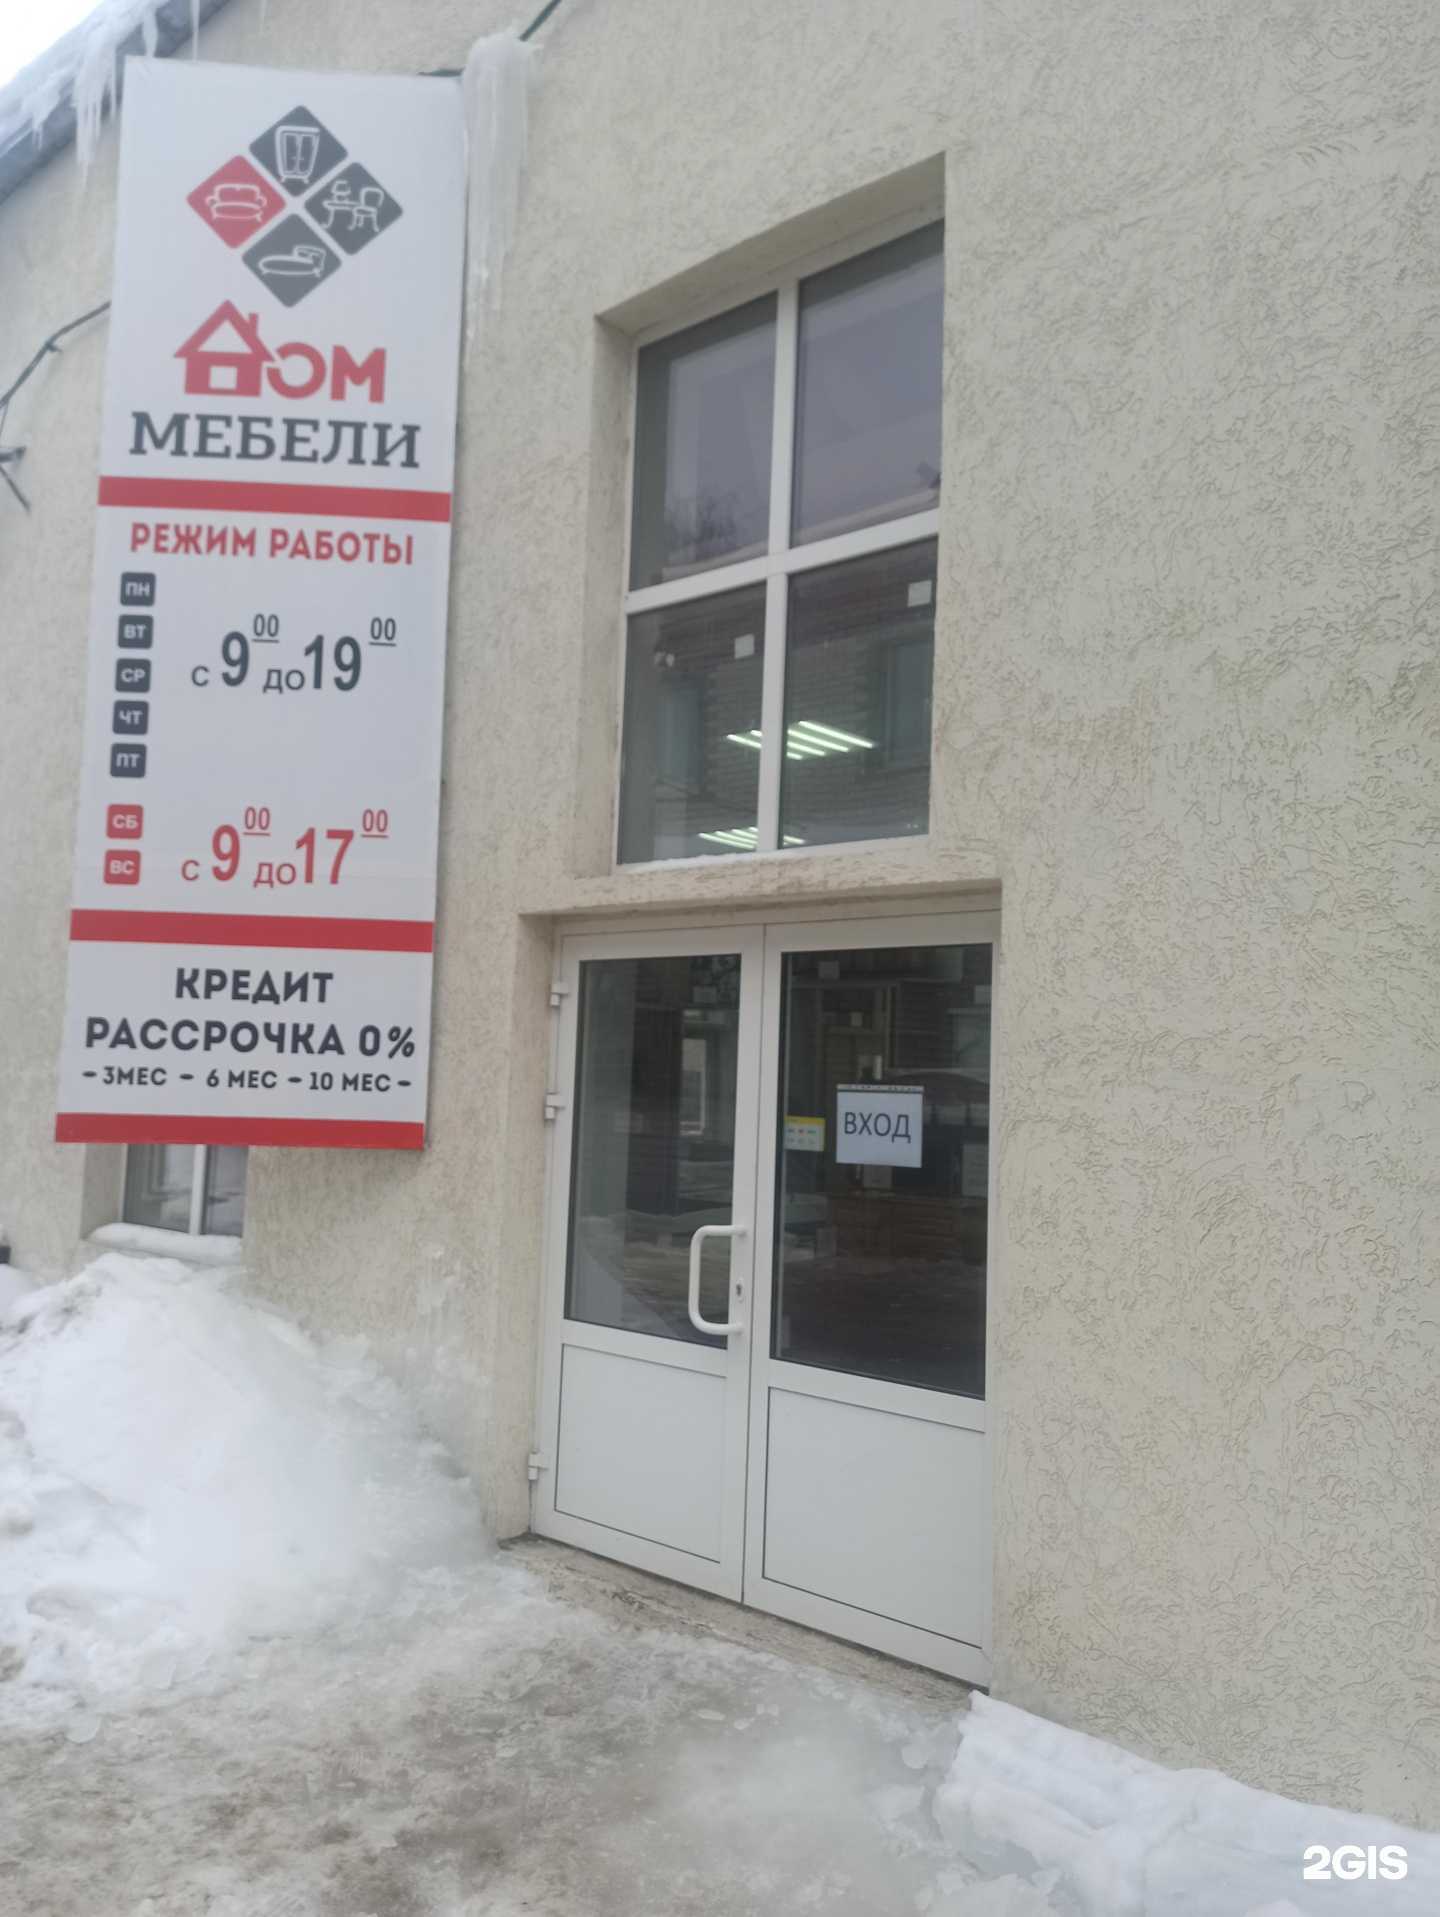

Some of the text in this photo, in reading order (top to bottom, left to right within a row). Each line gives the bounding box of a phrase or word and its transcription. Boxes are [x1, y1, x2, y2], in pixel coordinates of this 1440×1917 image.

[173, 299, 387, 403] ДОМ
[129, 411, 421, 469] МЕБЕЛИ
[130, 522, 414, 565] РЕЖИМ РАБОТЫ
[124, 581, 151, 597] ПН
[122, 623, 147, 639] ВТ
[120, 668, 146, 683] СР
[262, 668, 305, 694] до
[118, 710, 143, 725] ЧТ
[116, 753, 140, 768] ПТ
[112, 814, 138, 829] СБ
[109, 859, 135, 875] ВС
[253, 862, 296, 888] до
[175, 967, 334, 1004] КРЕДИТ
[84, 1016, 416, 1060] РАССРОЧКА 0%
[206, 1068, 219, 1089] 6
[227, 1070, 278, 1090] МЕС
[308, 1072, 334, 1092] 10
[341, 1073, 391, 1093] МЕС
[844, 1111, 912, 1144] ВХОД
